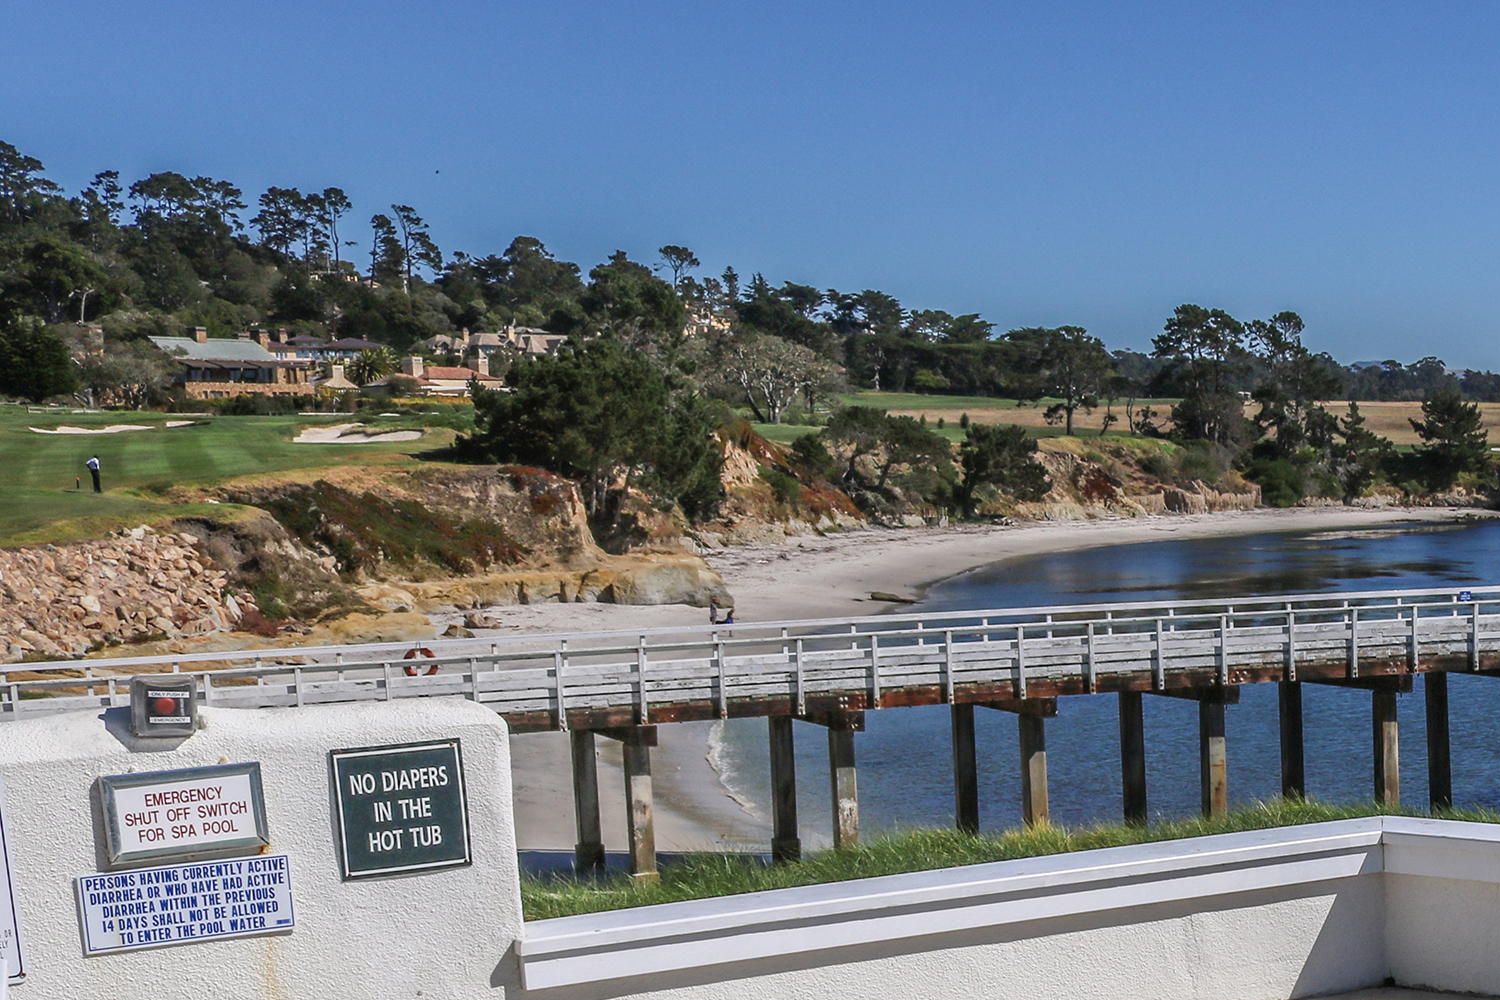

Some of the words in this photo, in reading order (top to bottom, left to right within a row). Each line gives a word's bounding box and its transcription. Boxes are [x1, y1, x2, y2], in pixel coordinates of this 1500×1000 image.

[349, 774, 376, 795] NO
[381, 766, 448, 792] DIAPERS
[145, 786, 223, 807] EMERGENCY
[374, 801, 392, 822] IN
[398, 797, 432, 819] THE
[125, 811, 159, 827] SHUT
[167, 808, 190, 821] OFF
[199, 802, 247, 819] SWITCH
[139, 828, 165, 843] FOR
[172, 824, 197, 839] SPA
[204, 820, 238, 835] POOL
[369, 830, 403, 852] HOT
[409, 826, 442, 847] TUB
[86, 875, 135, 892] PERSONS
[139, 870, 178, 885] HAVING
[183, 863, 243, 881] CURRENTLY
[248, 858, 285, 874] ACTIVE
[90, 887, 142, 906] DIARRHEA
[148, 885, 161, 898] OR
[165, 882, 188, 896] WHO
[192, 878, 218, 893] HAVE
[223, 875, 242, 889] HAD
[247, 872, 284, 887] ACTIVE
[102, 920, 114, 933] 14
[119, 917, 147, 931] DAYS
[153, 912, 185, 926] SHALL
[190, 908, 209, 922] NOT
[214, 906, 228, 919] BE
[232, 900, 279, 917] ALLOWED
[103, 901, 155, 919] DIARRHEA
[160, 896, 198, 911] WITHIN
[202, 893, 221, 906] THE
[226, 887, 275, 904] PREVIOUS
[120, 933, 133, 945] TO
[138, 927, 172, 943] ENTER
[176, 924, 195, 937] THE
[200, 920, 225, 934] POOL
[230, 916, 266, 931] WATER
